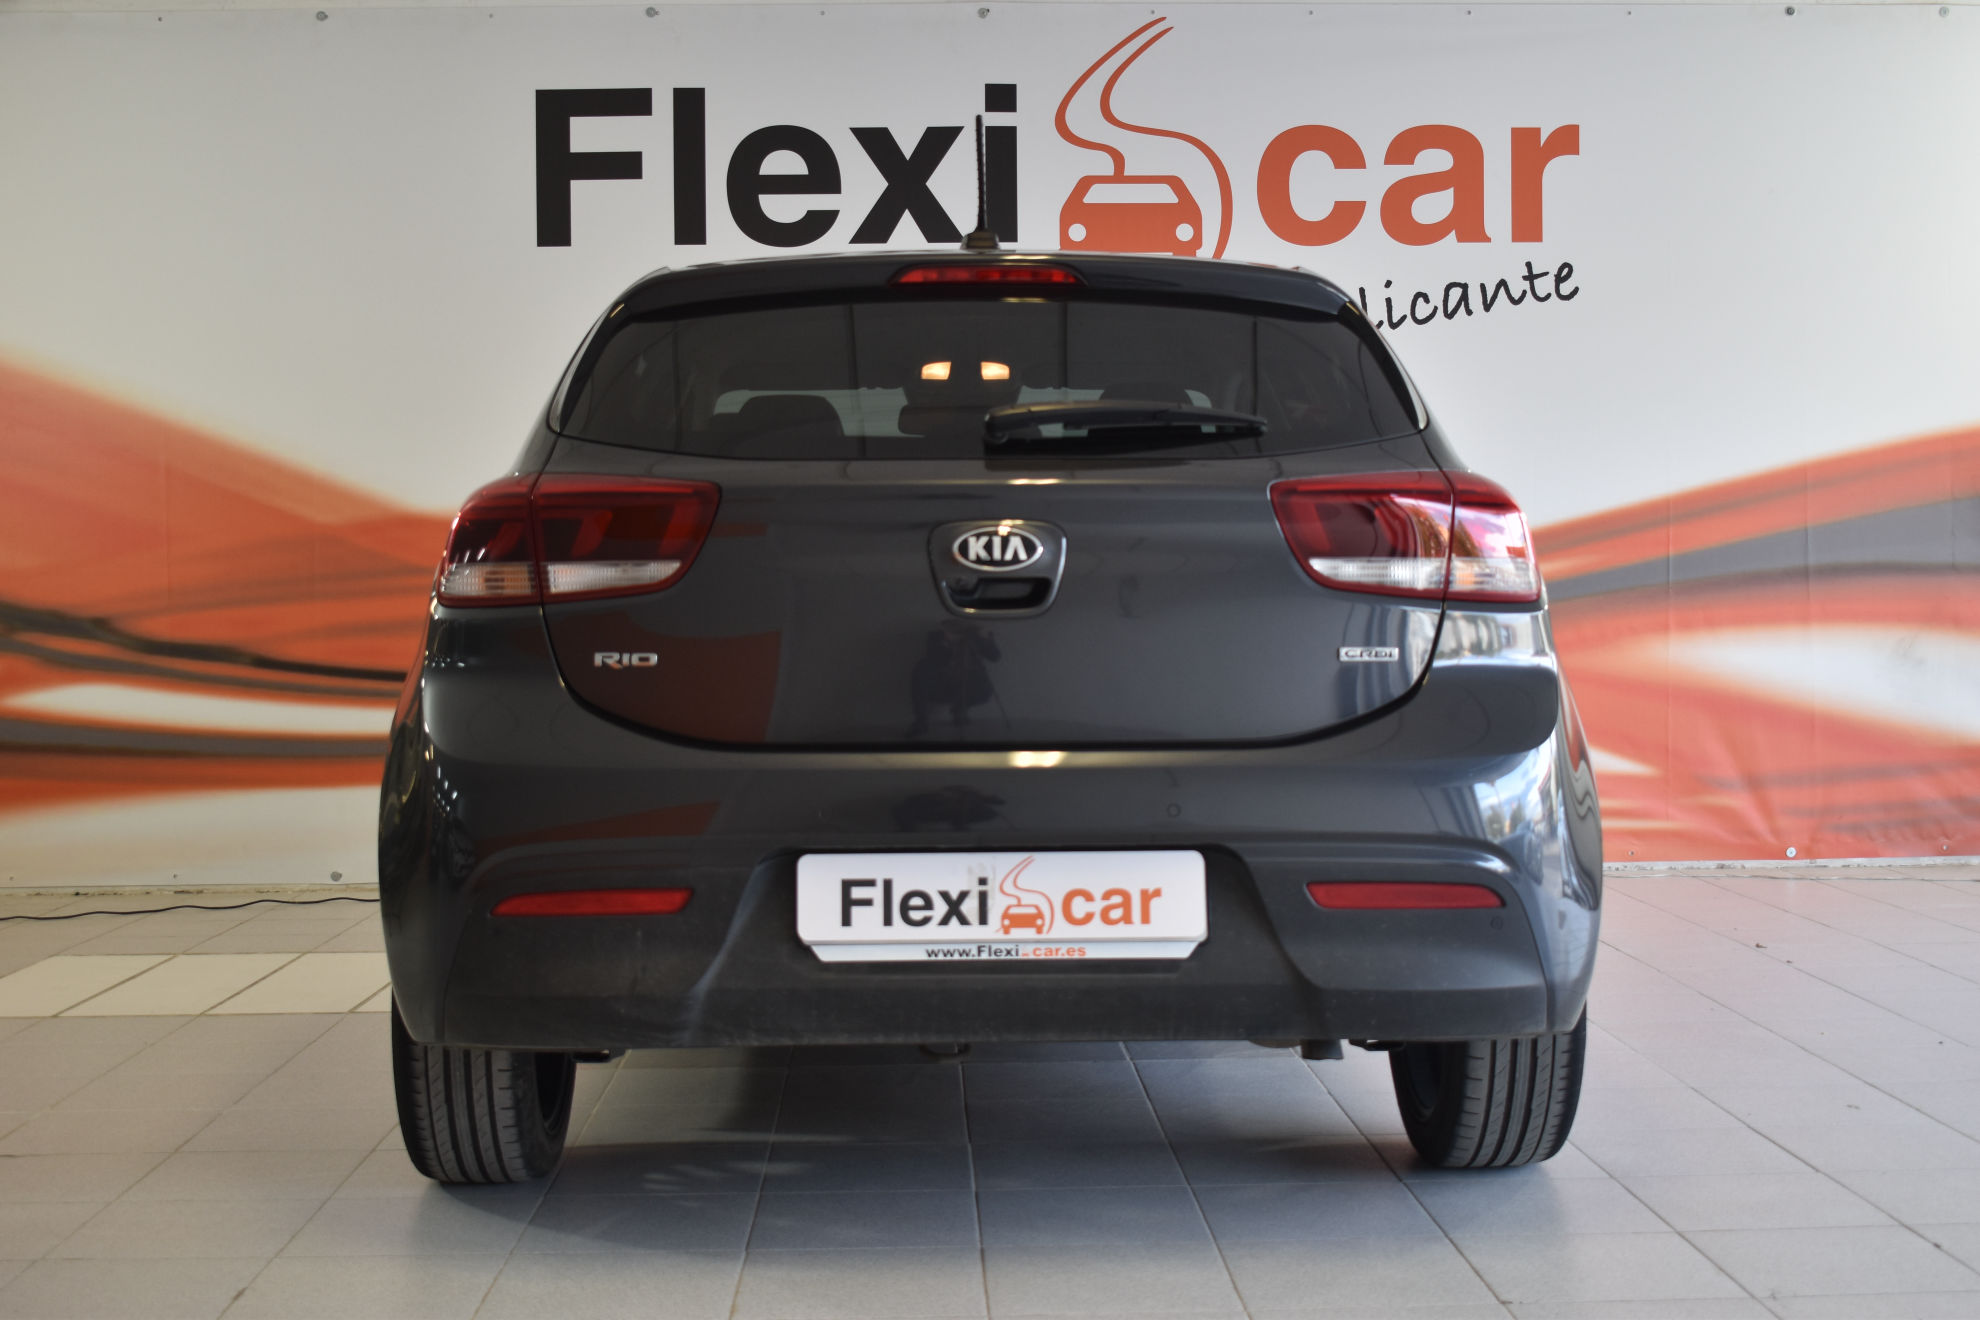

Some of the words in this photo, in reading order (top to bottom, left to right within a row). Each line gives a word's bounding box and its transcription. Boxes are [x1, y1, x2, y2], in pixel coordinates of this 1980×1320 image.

[535, 83, 1018, 247] Flexi
[1256, 123, 1580, 247] car
[967, 535, 1028, 561] KIA
[594, 651, 658, 669] RIO
[840, 877, 990, 928] Flexi
[1060, 886, 1163, 926] car
